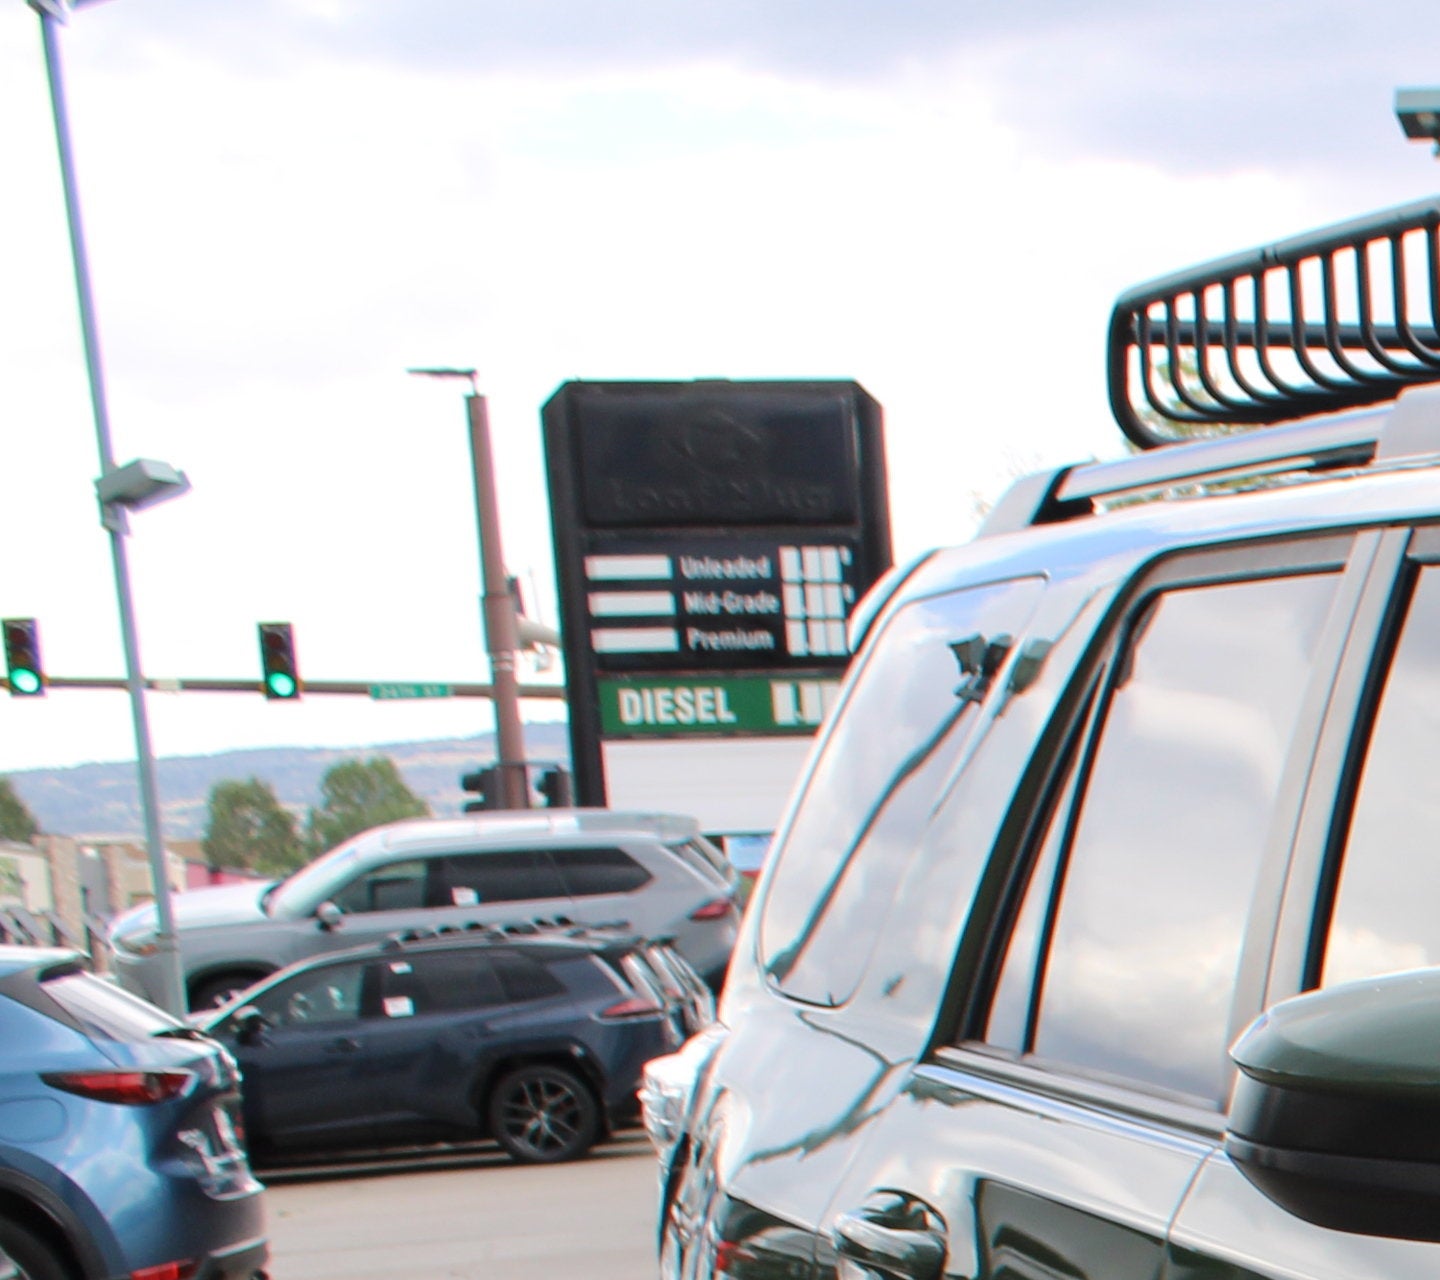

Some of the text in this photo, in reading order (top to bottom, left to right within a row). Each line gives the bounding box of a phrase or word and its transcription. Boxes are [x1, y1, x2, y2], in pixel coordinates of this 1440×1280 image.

[680, 555, 772, 581] Unleaded
[683, 590, 780, 616] Mid-Grade
[686, 627, 775, 651] Premium
[617, 686, 738, 726] DIESEL
